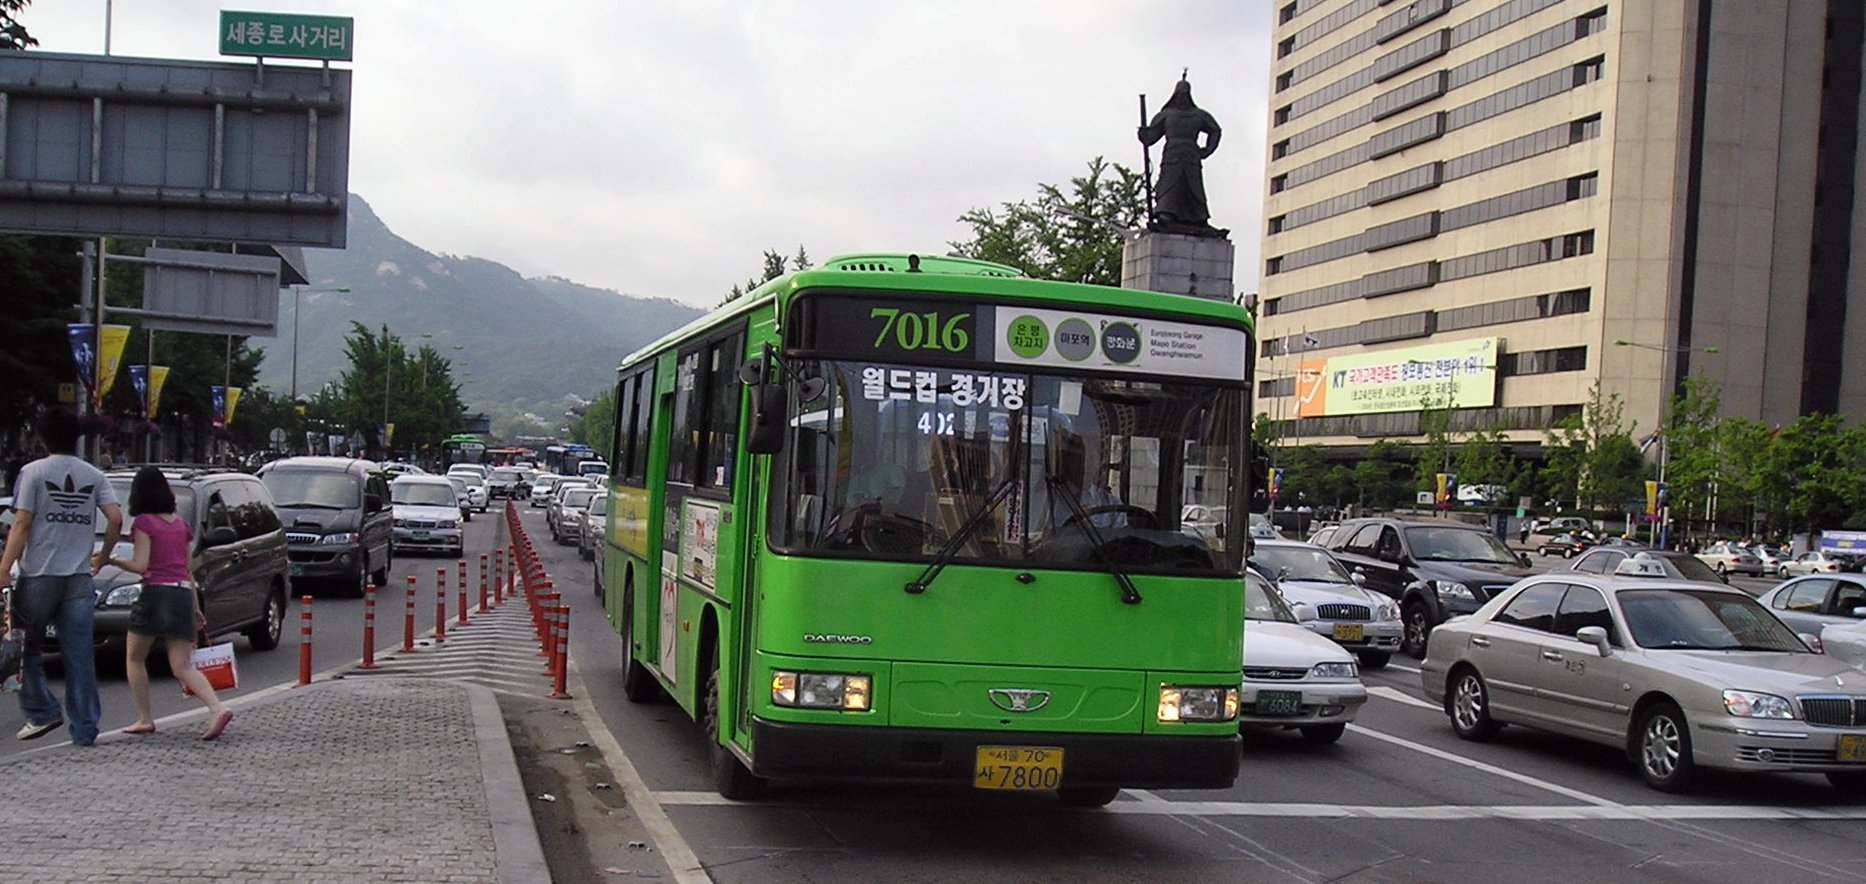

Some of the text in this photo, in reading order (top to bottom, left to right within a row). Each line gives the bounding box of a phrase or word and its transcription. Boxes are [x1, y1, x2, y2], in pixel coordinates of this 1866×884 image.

[226, 21, 346, 50] 세종로사거리
[870, 307, 971, 352] 7016
[1013, 336, 1043, 349] 차고지
[1060, 332, 1091, 347] 마포역
[1106, 335, 1136, 351] 광화문
[1150, 339, 1197, 350] Mapo Station
[1332, 369, 1347, 389] KT
[862, 366, 1027, 410] 월드컵 경기장
[45, 511, 92, 526] adidas
[803, 633, 873, 646] DAEWOO
[996, 749, 1045, 763] 서울 70
[978, 765, 1059, 788] 사 7800
